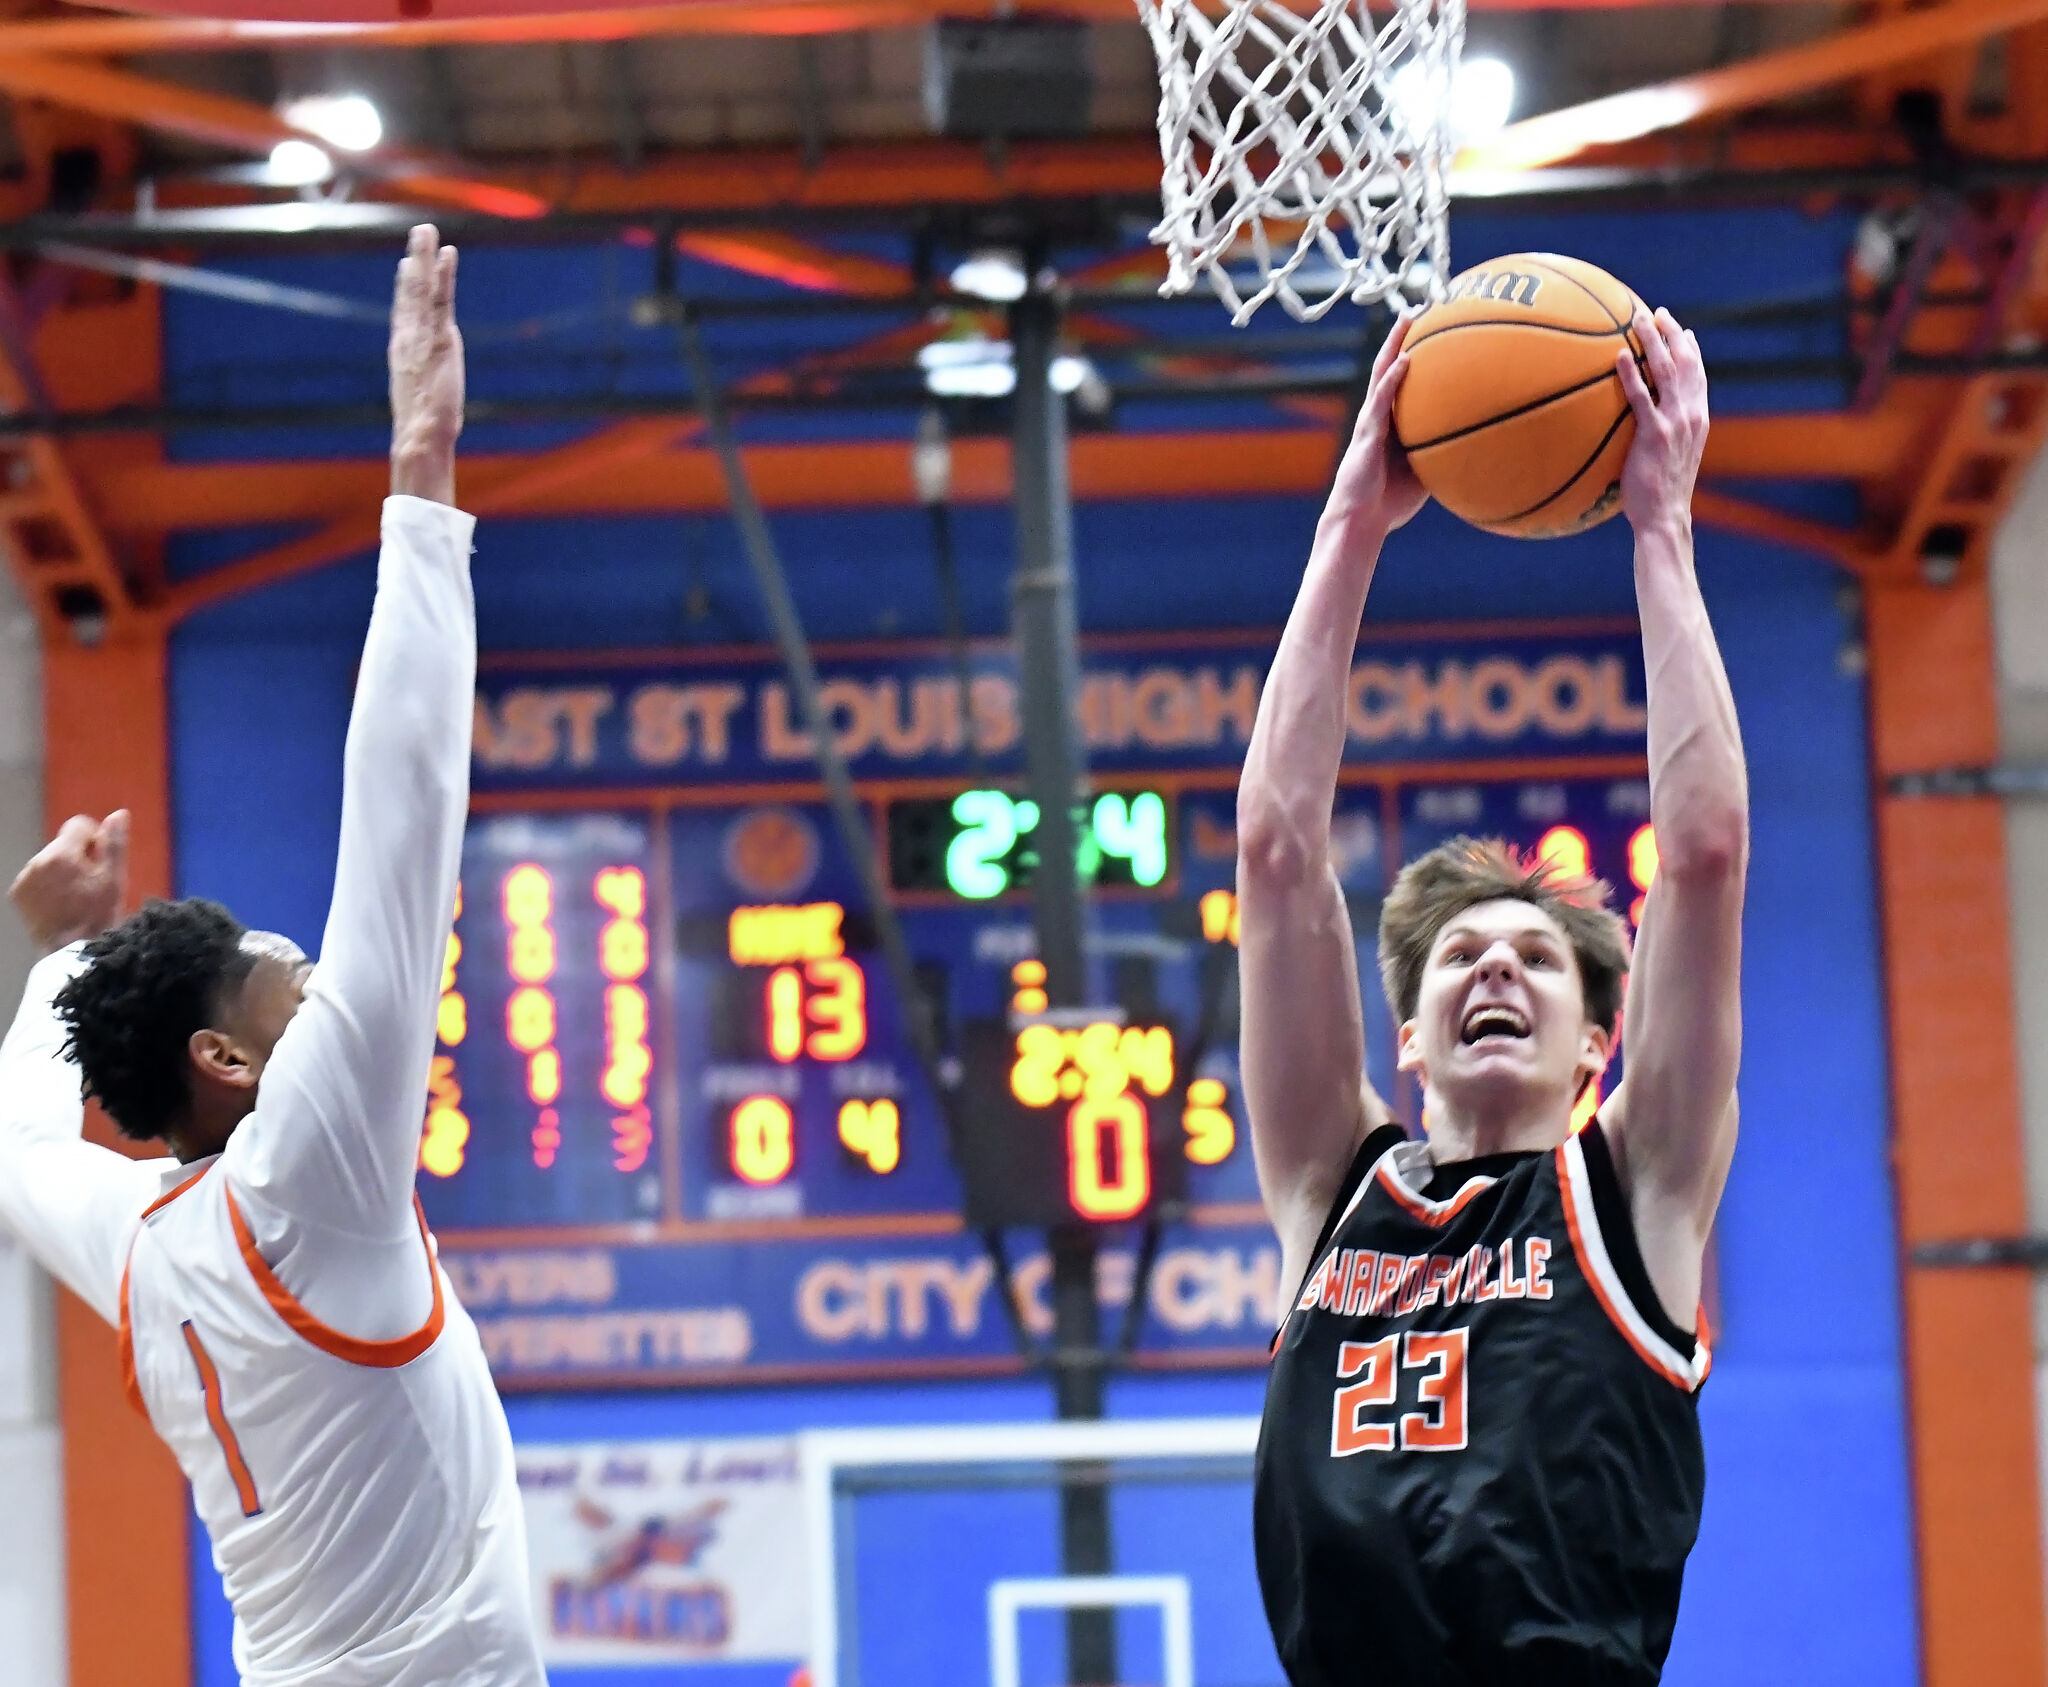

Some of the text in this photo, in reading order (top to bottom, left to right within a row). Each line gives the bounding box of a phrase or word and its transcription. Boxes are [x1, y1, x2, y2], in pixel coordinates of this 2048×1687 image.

[472, 682, 613, 770] AST
[628, 682, 745, 768] ST
[757, 676, 1022, 760] LOUIS
[1346, 654, 1649, 740] CHOOL
[766, 956, 867, 1062] 13
[731, 1095, 900, 1185] 0 4
[1067, 1090, 1150, 1223] 0
[797, 1255, 994, 1342] CITY
[1296, 1237, 1553, 1317] WARDSVILLE
[181, 1318, 263, 1518] 1
[1330, 1326, 1470, 1458] 23
